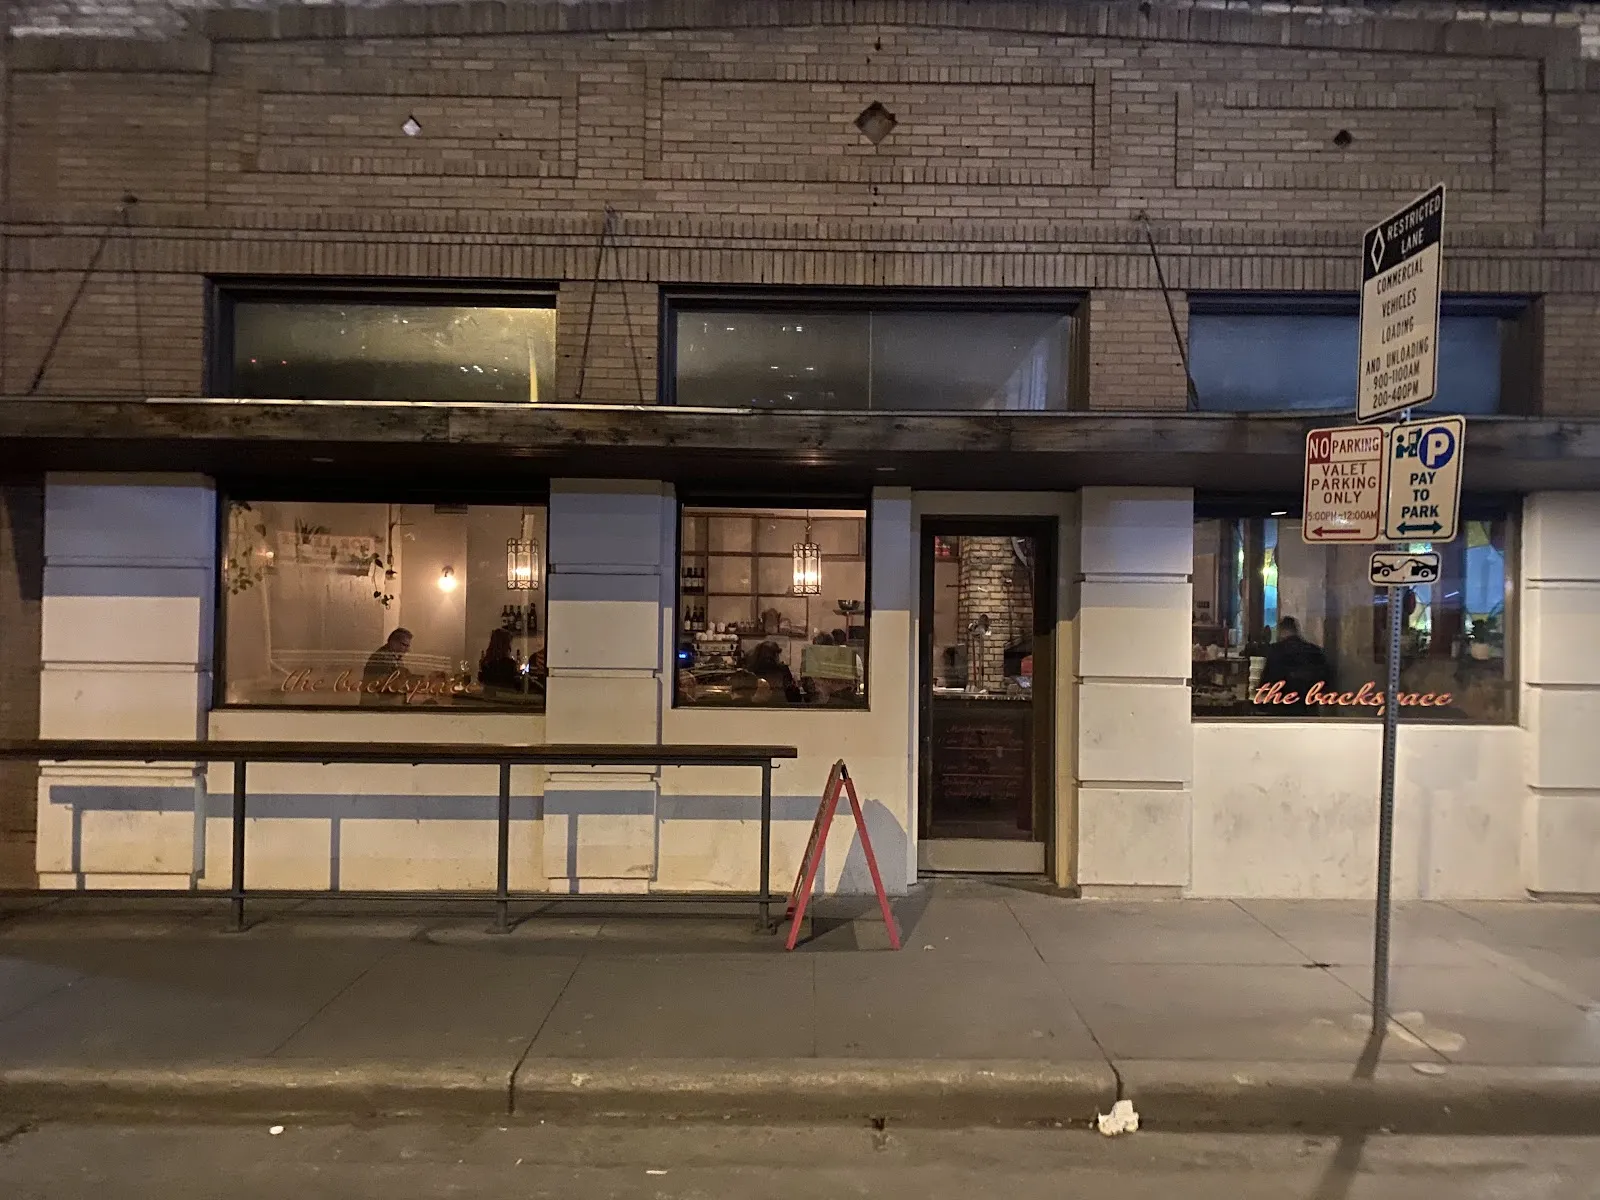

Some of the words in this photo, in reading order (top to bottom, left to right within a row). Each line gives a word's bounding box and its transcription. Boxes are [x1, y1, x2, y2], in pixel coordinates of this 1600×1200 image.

[1387, 194, 1441, 242] RESTRICTED
[1401, 227, 1425, 255] LANE
[1377, 257, 1424, 295] COMMERCIAL
[1381, 288, 1417, 318] VEHICLES
[1382, 316, 1414, 345] LOADING
[1366, 357, 1381, 376] AND
[1386, 336, 1429, 368] UNLOADING
[1310, 437, 1330, 459] NO
[1332, 437, 1379, 454] PARKING
[1322, 463, 1367, 476] VALET
[1409, 471, 1437, 486] PAY
[1311, 476, 1377, 491] PARKING
[1413, 489, 1430, 501] TO
[1323, 490, 1362, 504] ONLY
[1401, 505, 1439, 519] PARK
[280, 669, 325, 693] the
[1252, 680, 1300, 705] the
